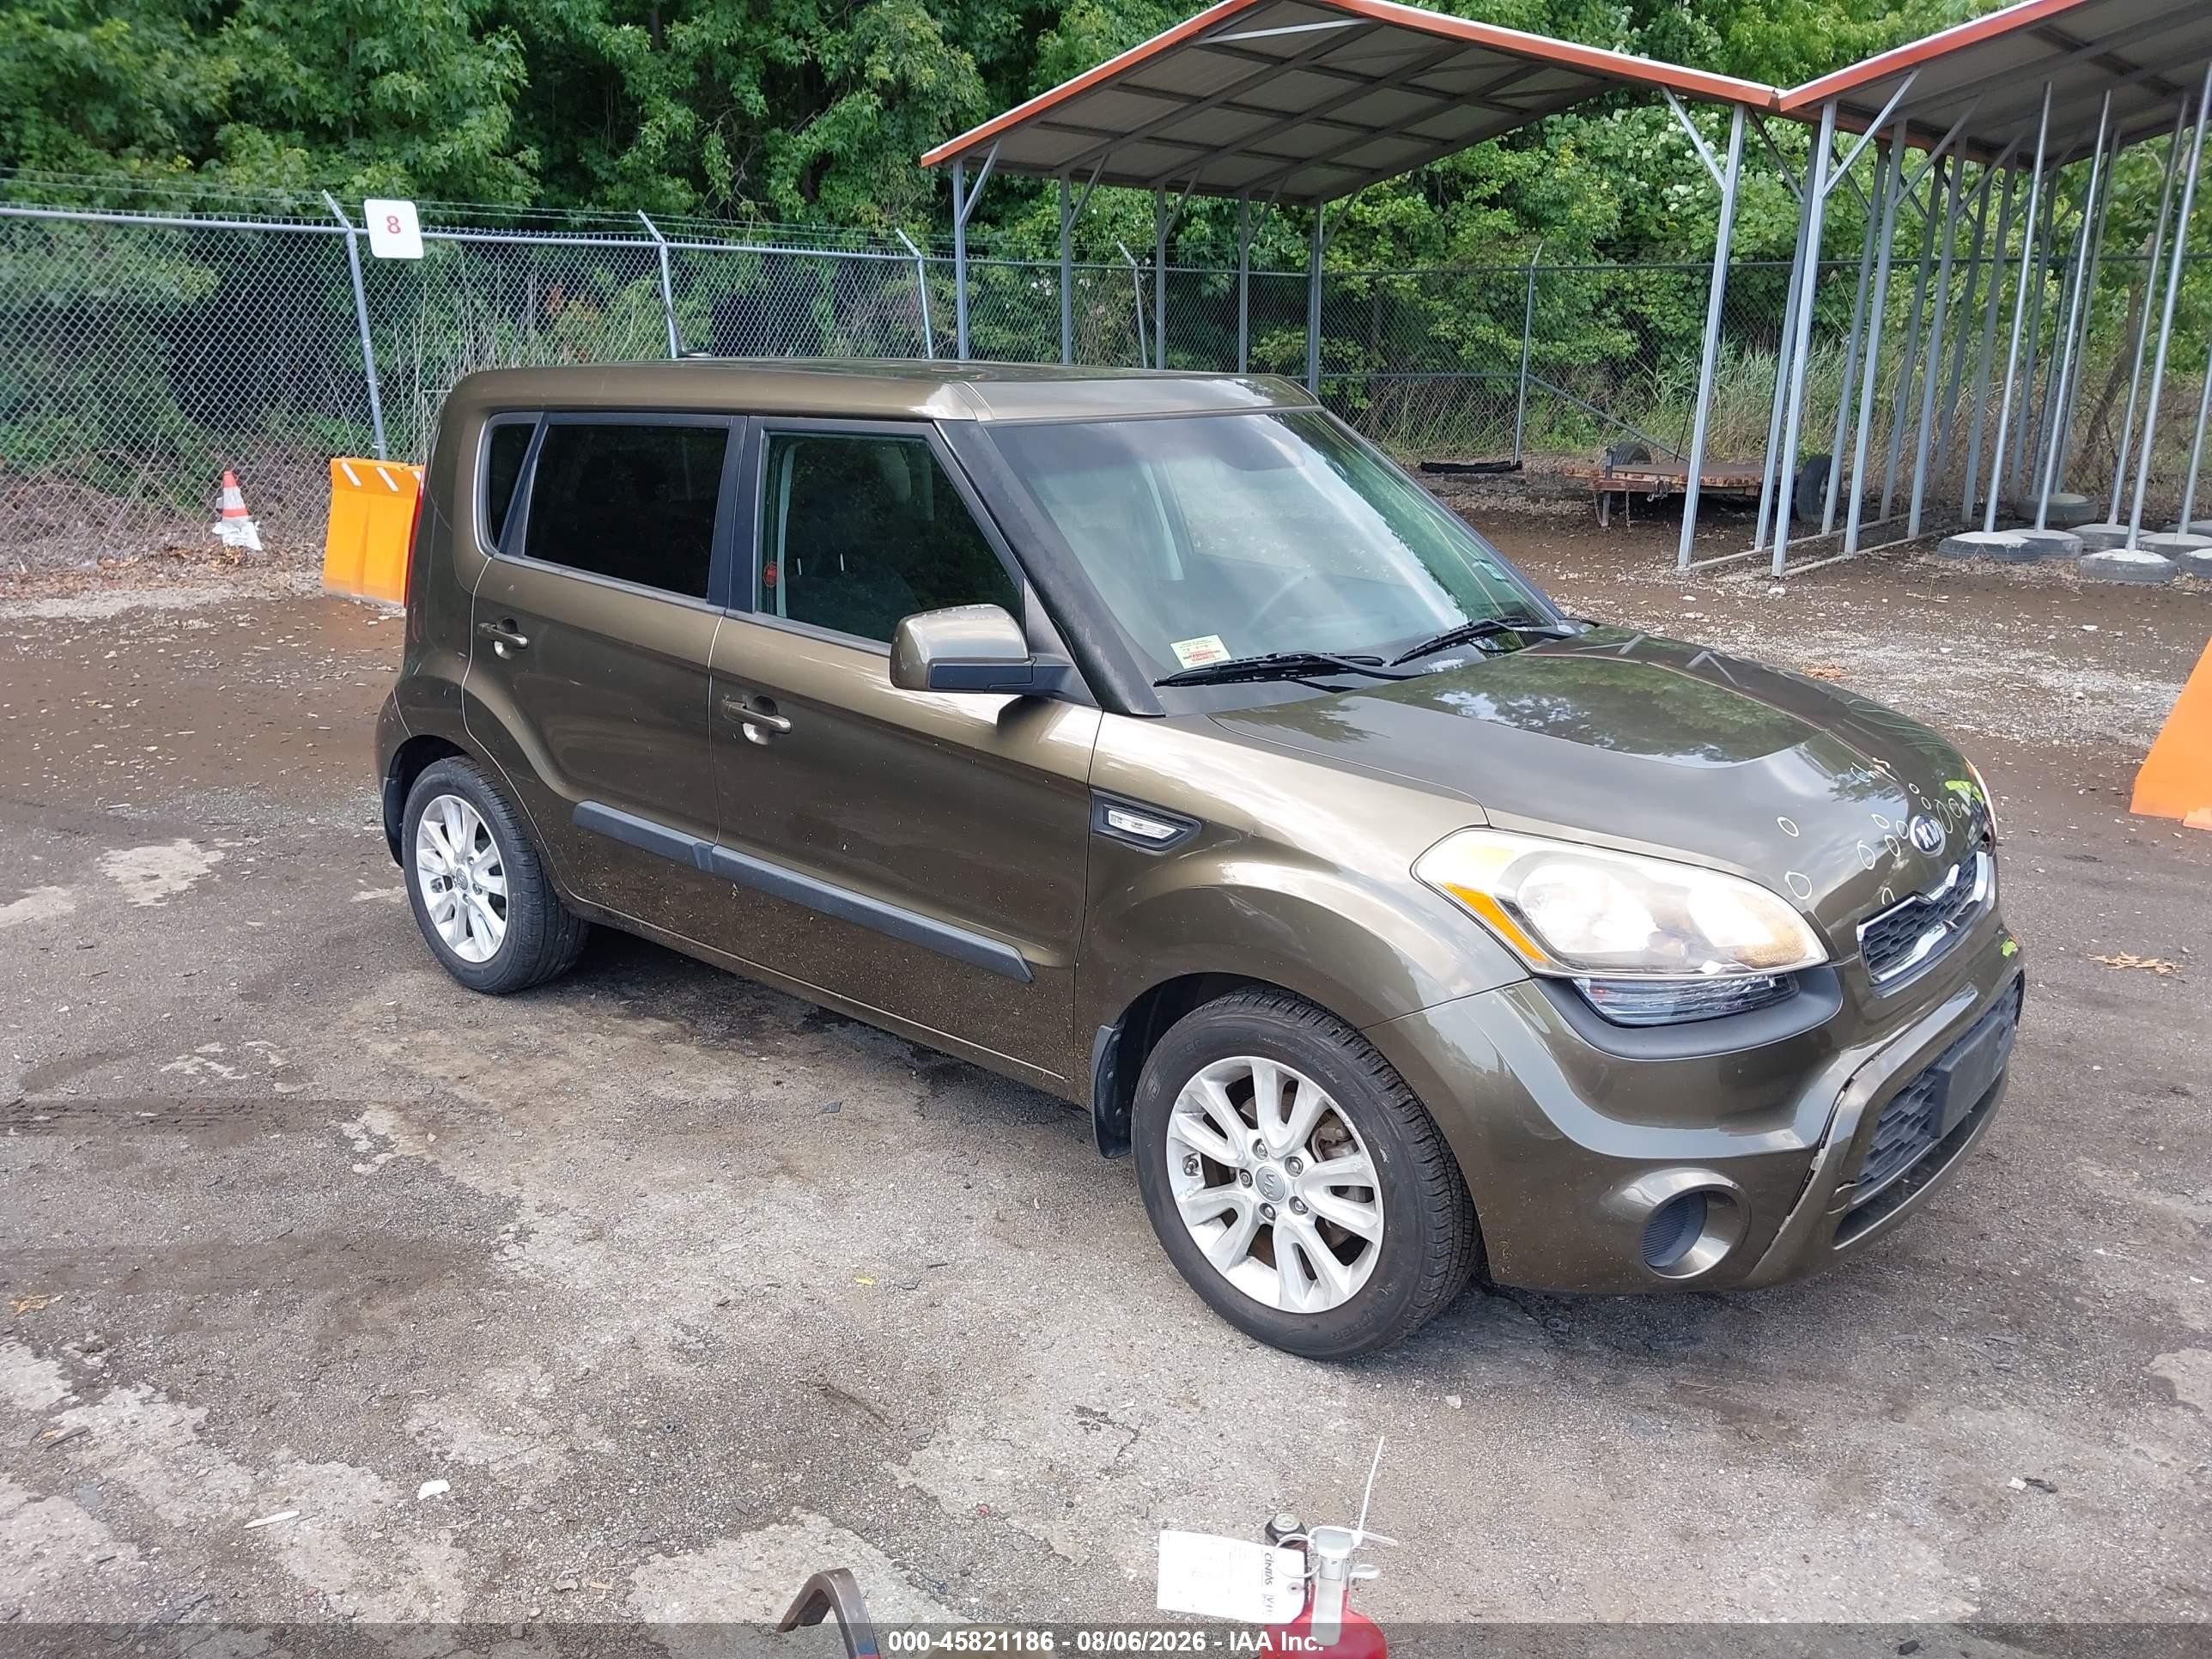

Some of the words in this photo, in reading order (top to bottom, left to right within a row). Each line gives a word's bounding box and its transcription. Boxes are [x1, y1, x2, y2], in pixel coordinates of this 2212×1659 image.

[386, 216, 401, 234] 8
[1915, 819, 1942, 849] KIA
[1264, 1552, 1275, 1586] CINTAS
